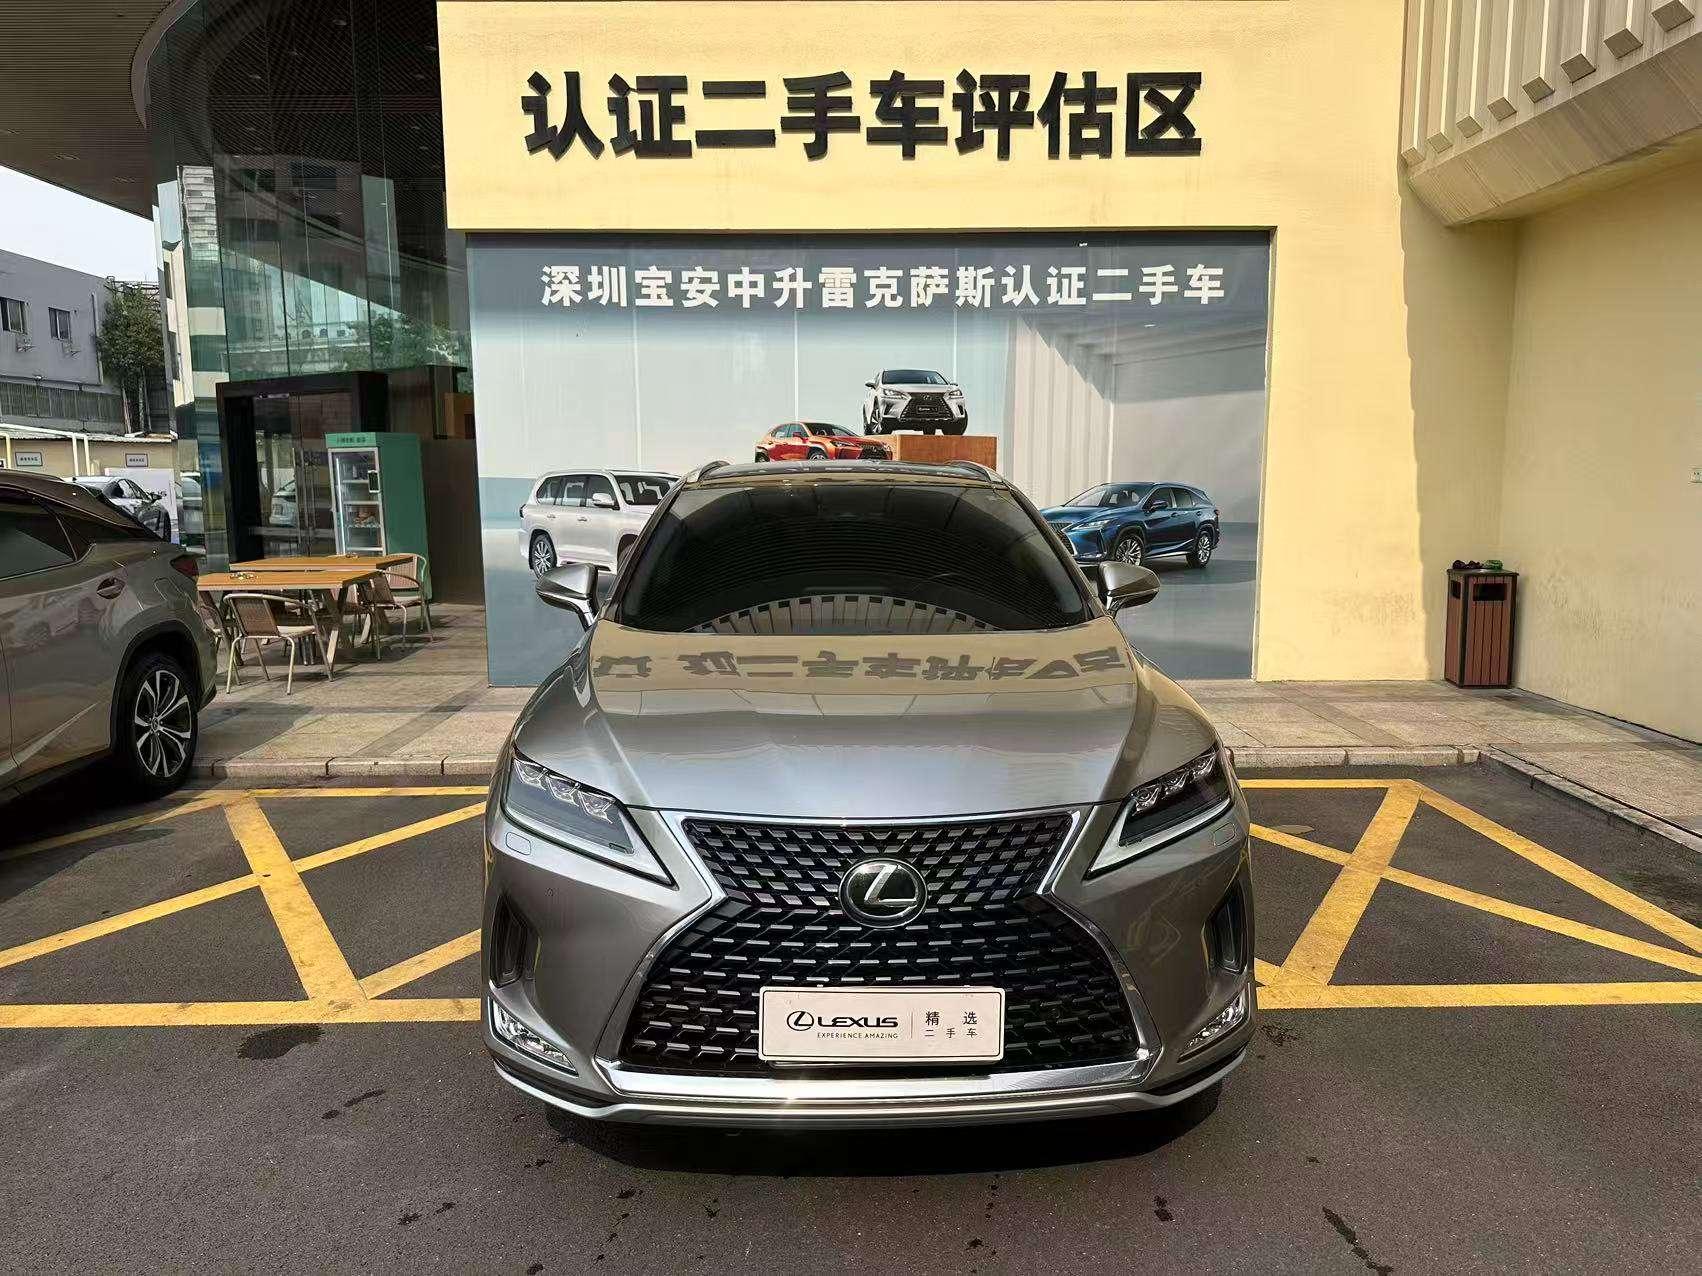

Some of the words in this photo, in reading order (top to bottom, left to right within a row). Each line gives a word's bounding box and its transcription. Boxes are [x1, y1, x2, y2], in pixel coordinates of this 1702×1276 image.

[520, 68, 1203, 160] 认证二手车评估区
[539, 263, 1226, 309] 深圳宝安中升雷克萨斯认证二手车
[817, 1016, 899, 1028] LEXUS
[924, 1027, 979, 1039] 二手车
